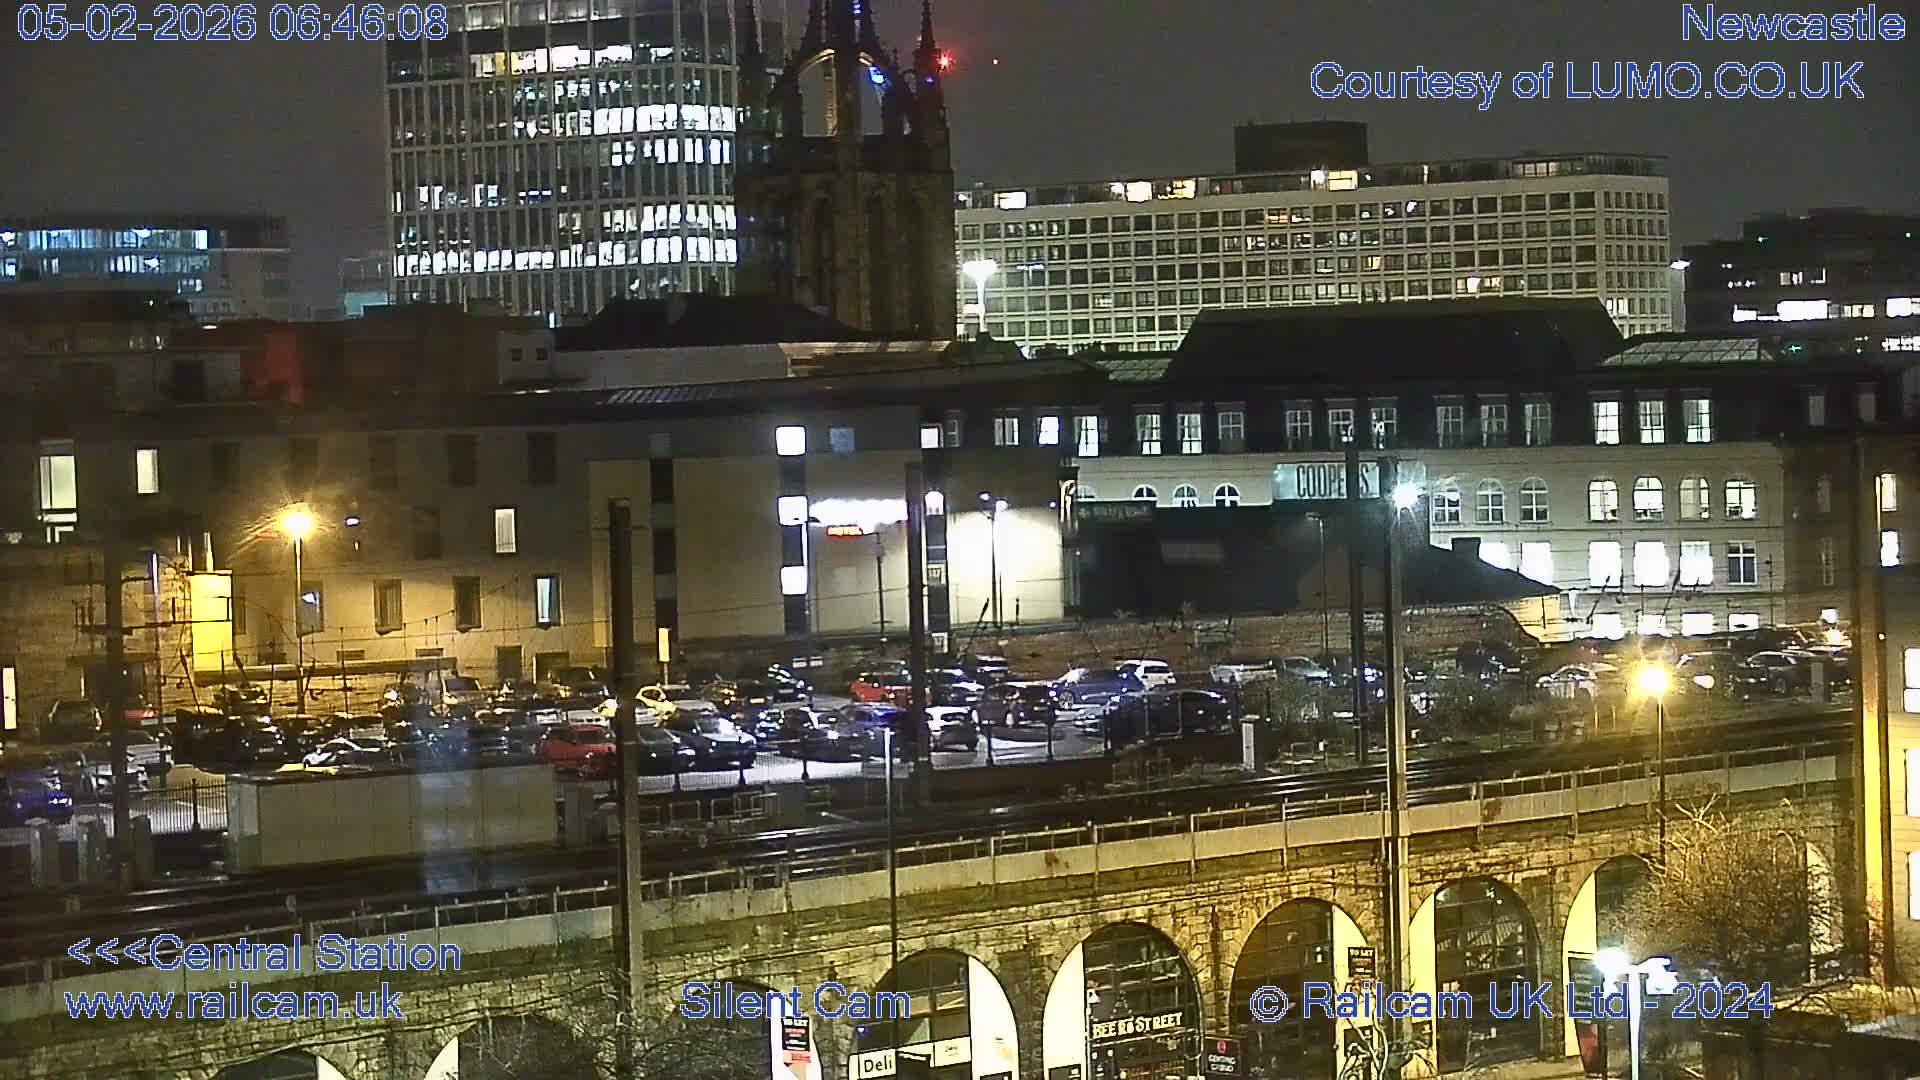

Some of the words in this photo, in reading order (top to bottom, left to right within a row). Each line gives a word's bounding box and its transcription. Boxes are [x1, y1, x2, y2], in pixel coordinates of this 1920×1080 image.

[1296, 464, 1370, 498] COOPES
[1135, 1012, 1183, 1033] STREET
[864, 1055, 893, 1073] Deli
